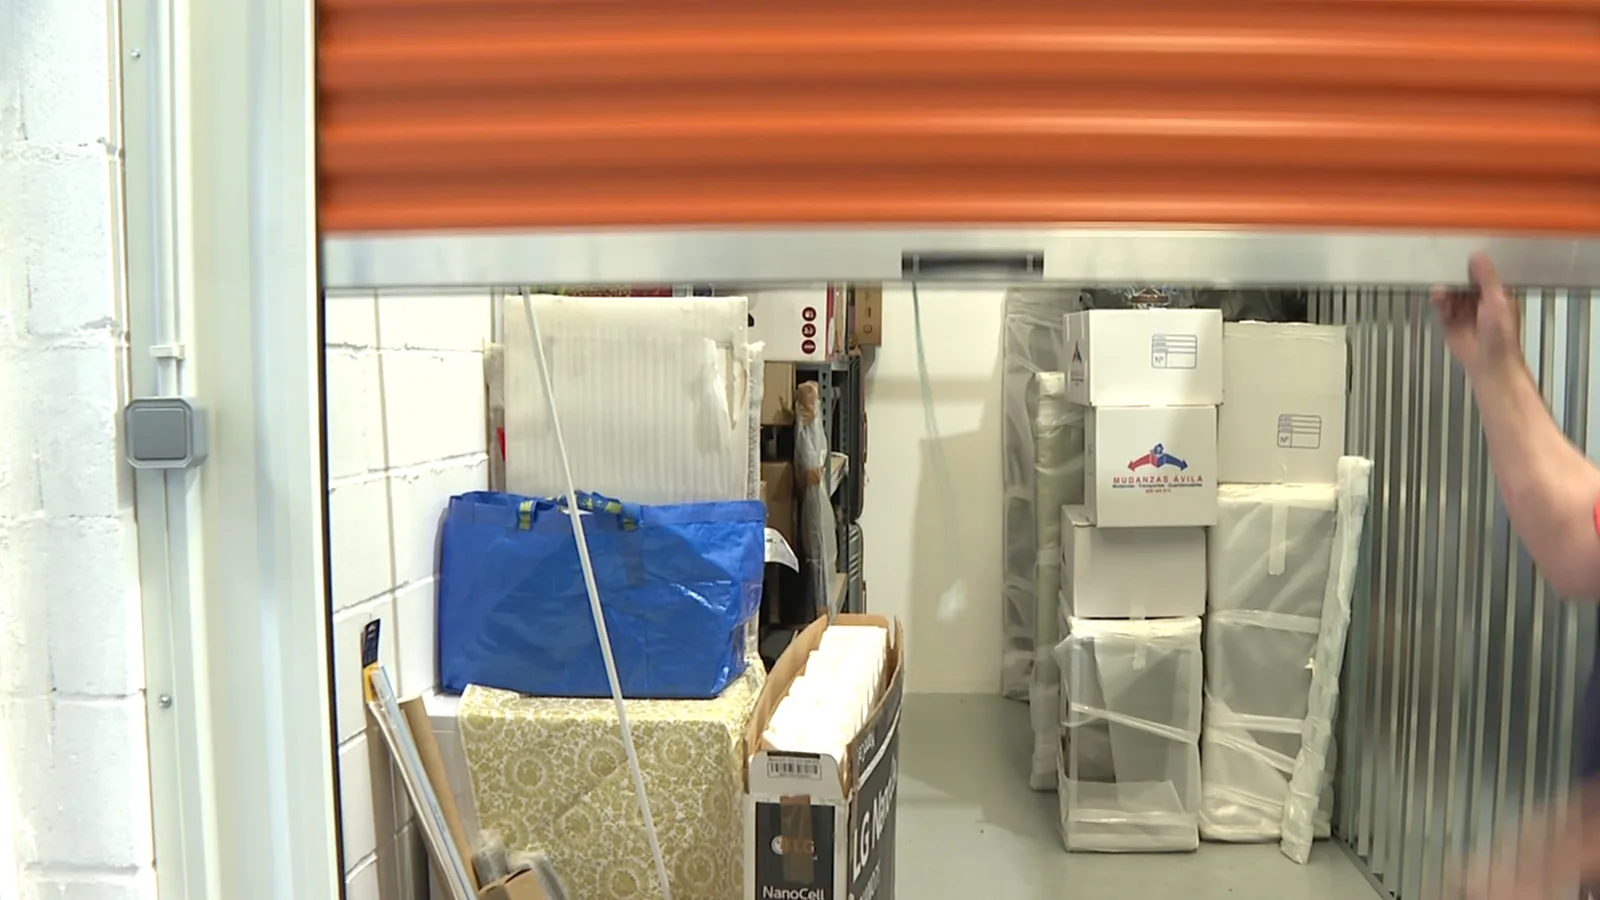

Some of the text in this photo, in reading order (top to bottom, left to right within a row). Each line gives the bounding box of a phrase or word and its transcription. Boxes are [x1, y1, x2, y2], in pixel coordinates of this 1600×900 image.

[1113, 476, 1169, 484] MUDANZAS
[852, 811, 871, 883] LG
[762, 885, 826, 900] NanoCell
